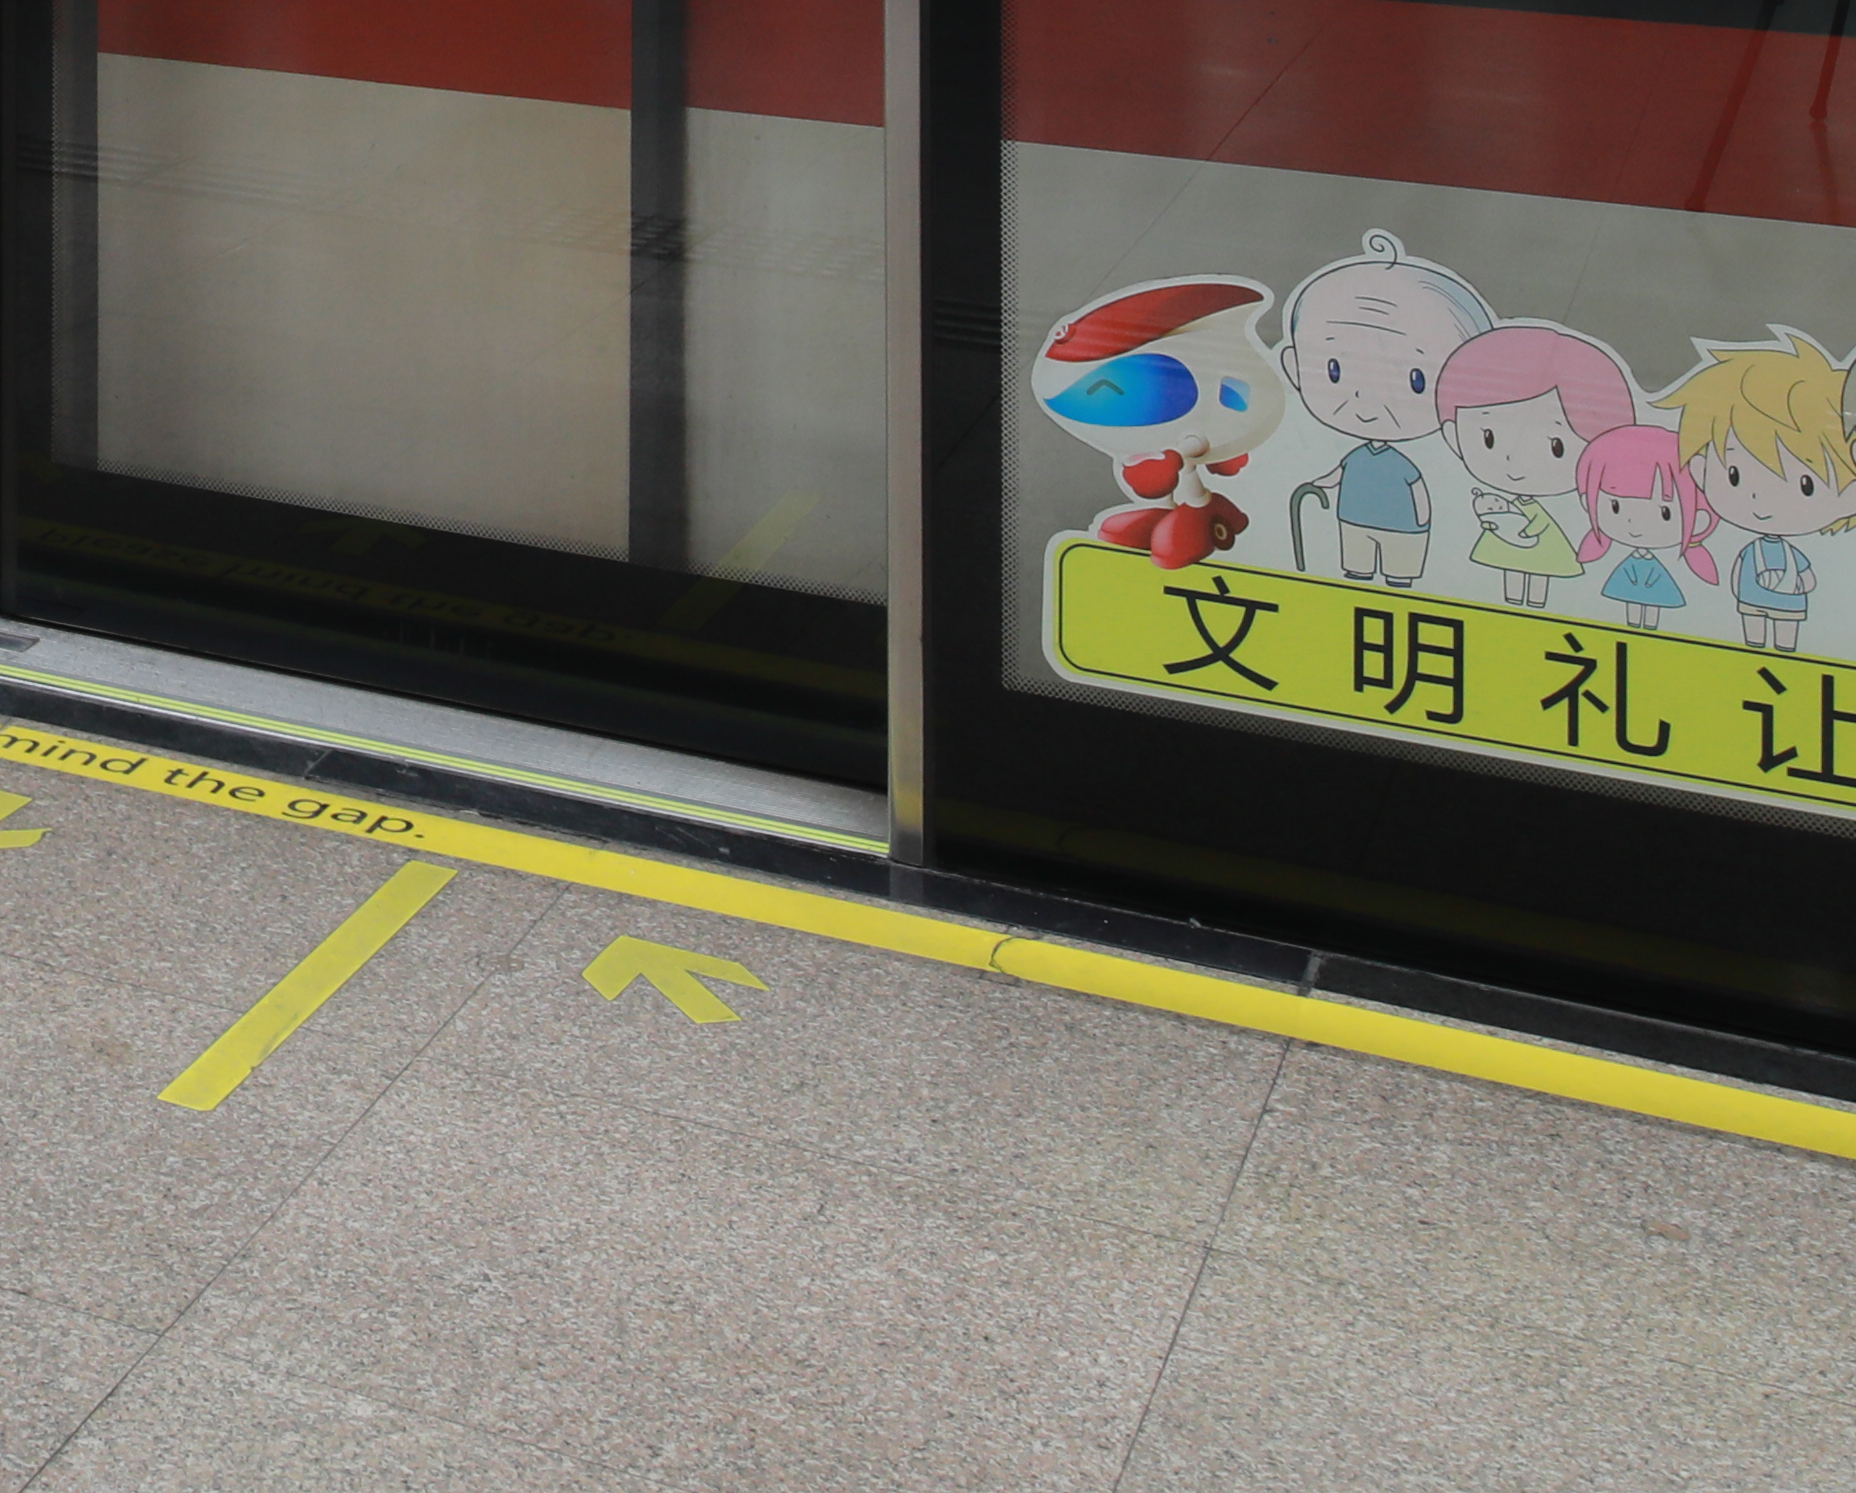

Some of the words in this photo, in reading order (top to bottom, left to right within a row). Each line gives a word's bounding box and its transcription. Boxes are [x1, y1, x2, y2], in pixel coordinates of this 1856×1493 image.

[1162, 574, 1856, 784] 文明礼让
[164, 763, 268, 804] the
[281, 792, 426, 842] gap.
